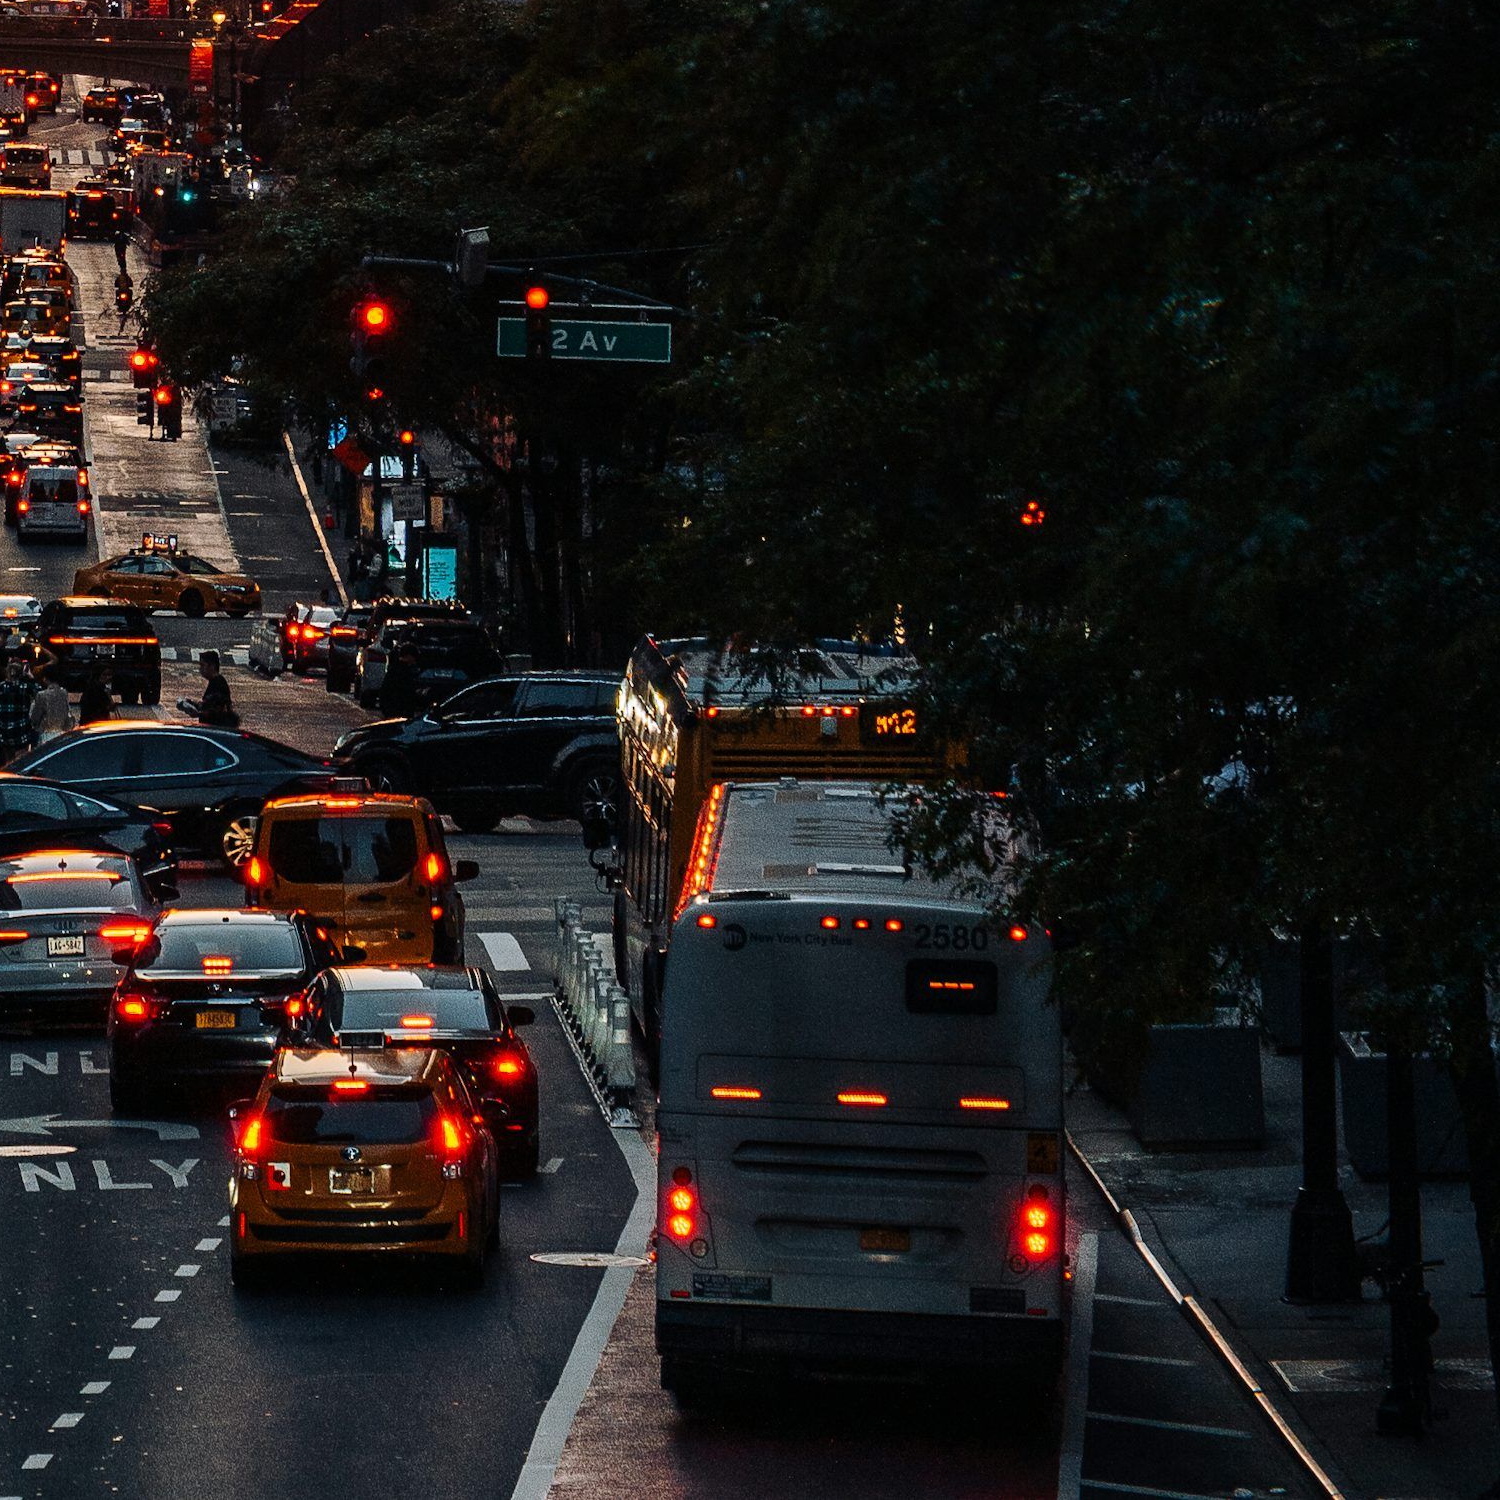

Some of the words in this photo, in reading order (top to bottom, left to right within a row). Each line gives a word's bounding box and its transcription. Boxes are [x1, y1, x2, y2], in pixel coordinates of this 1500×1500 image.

[552, 329, 568, 349] 2
[579, 330, 618, 351] Av
[776, 933, 800, 945] York
[804, 934, 827, 947] City
[830, 934, 851, 947] Bus
[914, 924, 989, 950] 2580
